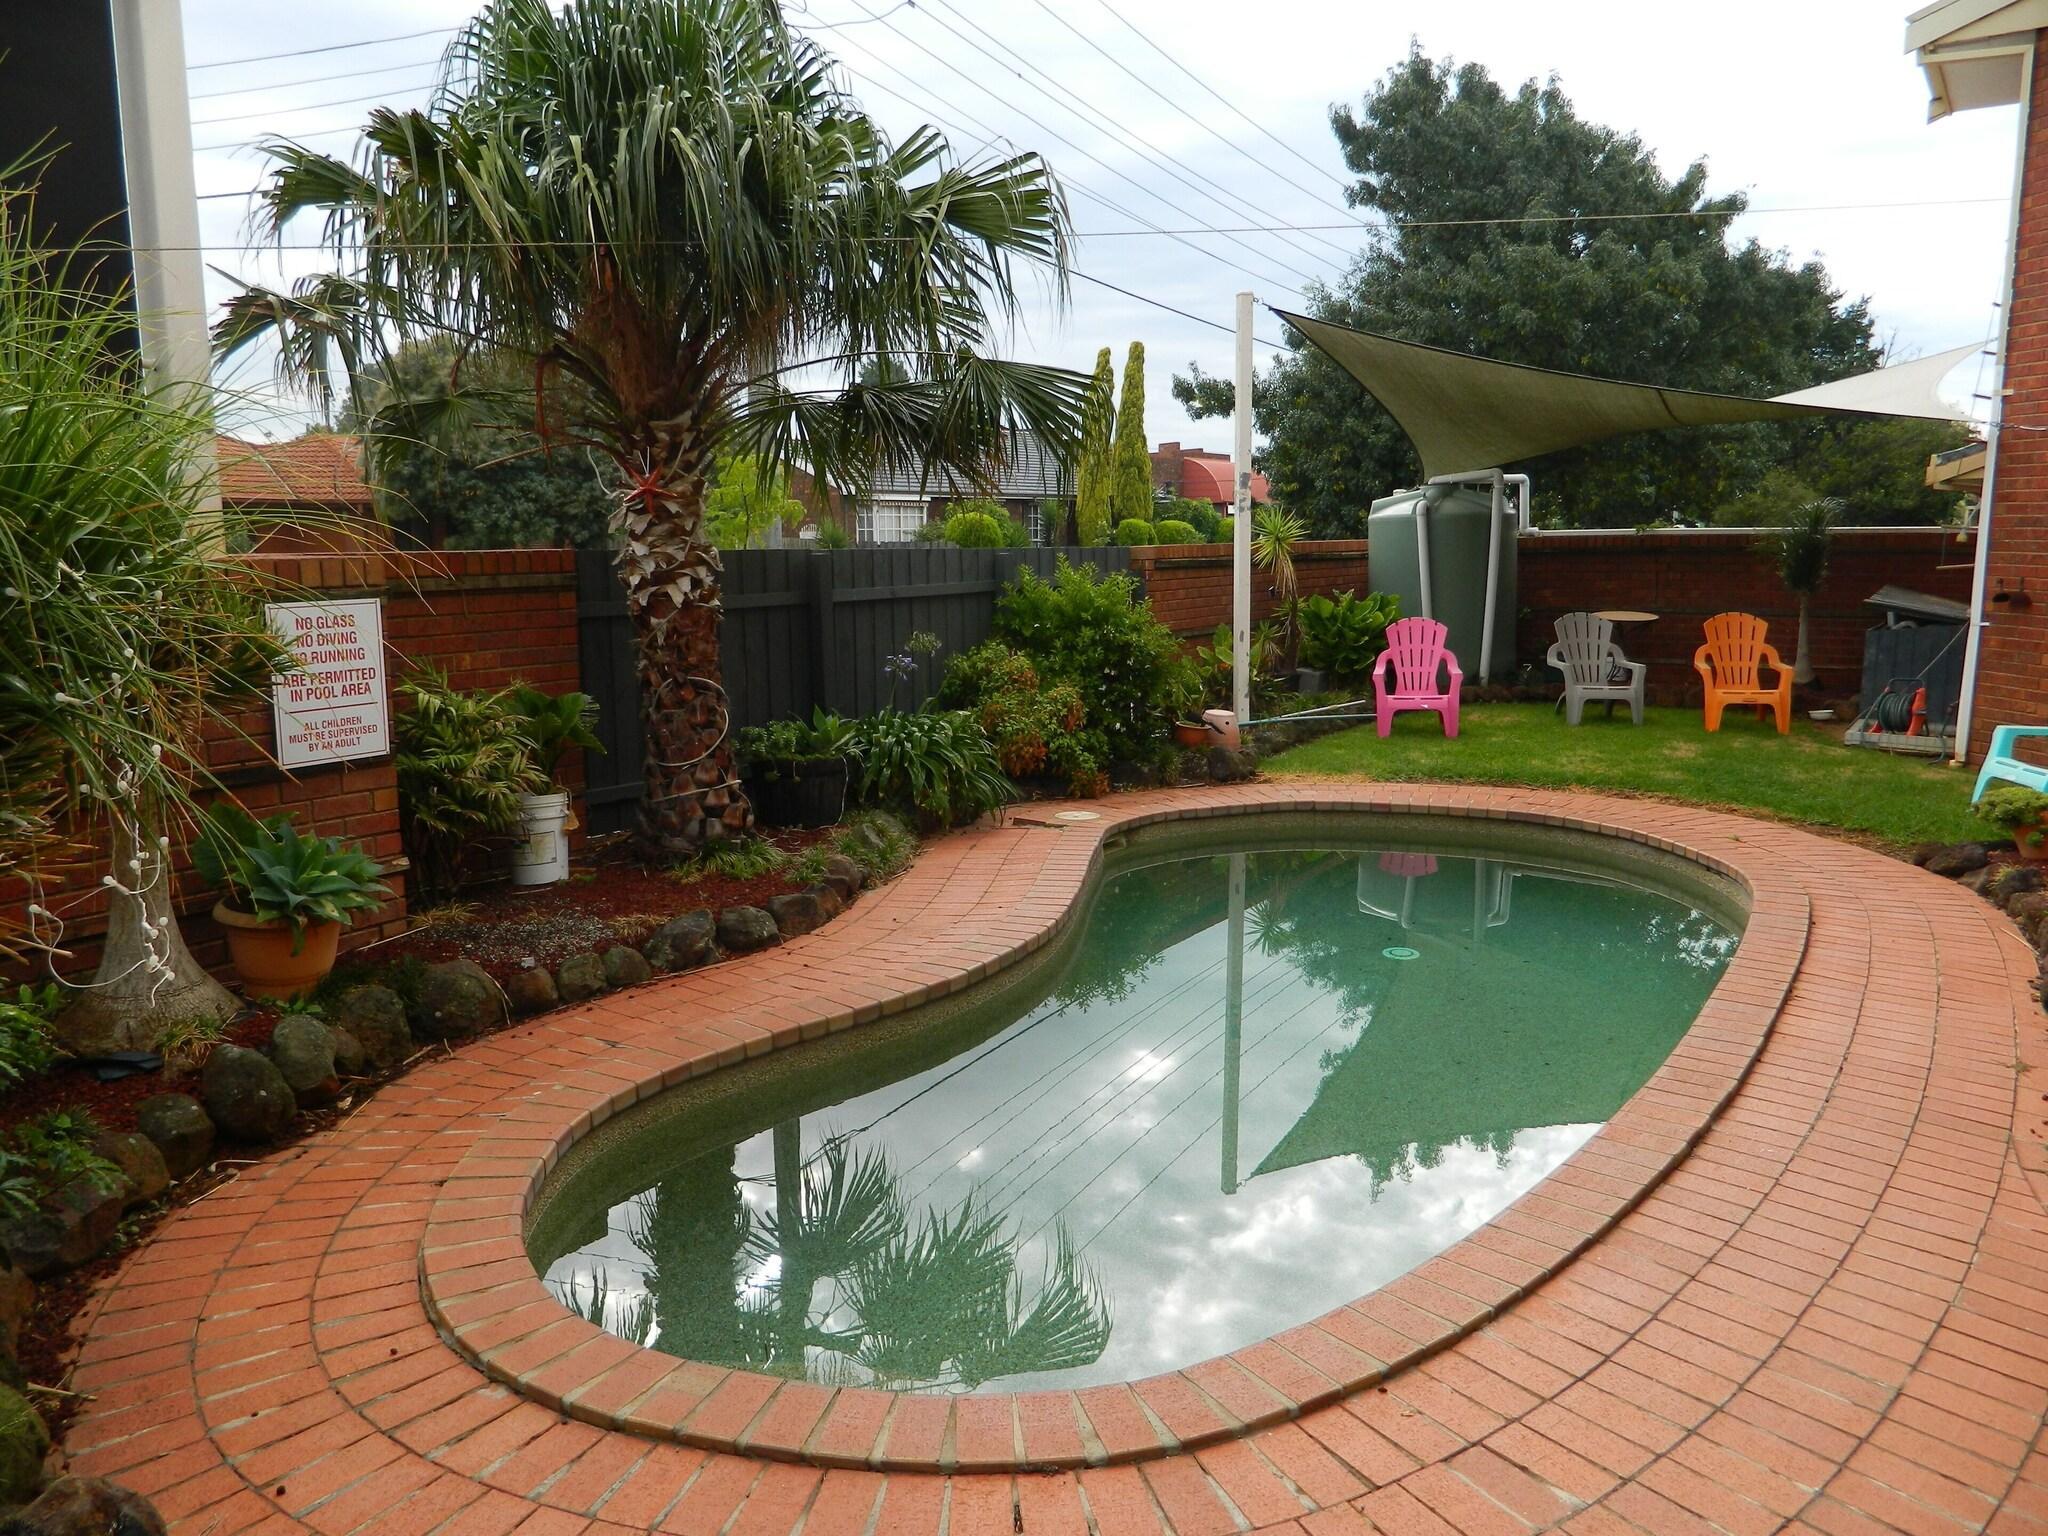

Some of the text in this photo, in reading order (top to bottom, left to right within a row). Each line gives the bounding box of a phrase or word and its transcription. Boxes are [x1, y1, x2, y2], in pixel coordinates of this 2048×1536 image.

[295, 614, 356, 631] NO GLASS
[296, 631, 357, 648] NO DIVING
[311, 647, 366, 664] RUNNING
[282, 667, 376, 688] ARE PERMITTED
[290, 682, 372, 702] IN POOL AREA
[304, 715, 362, 732] ALL CHILDREN
[289, 724, 378, 744] MUST BE SUPERVISED
[308, 736, 361, 752] BY AN ADULT
